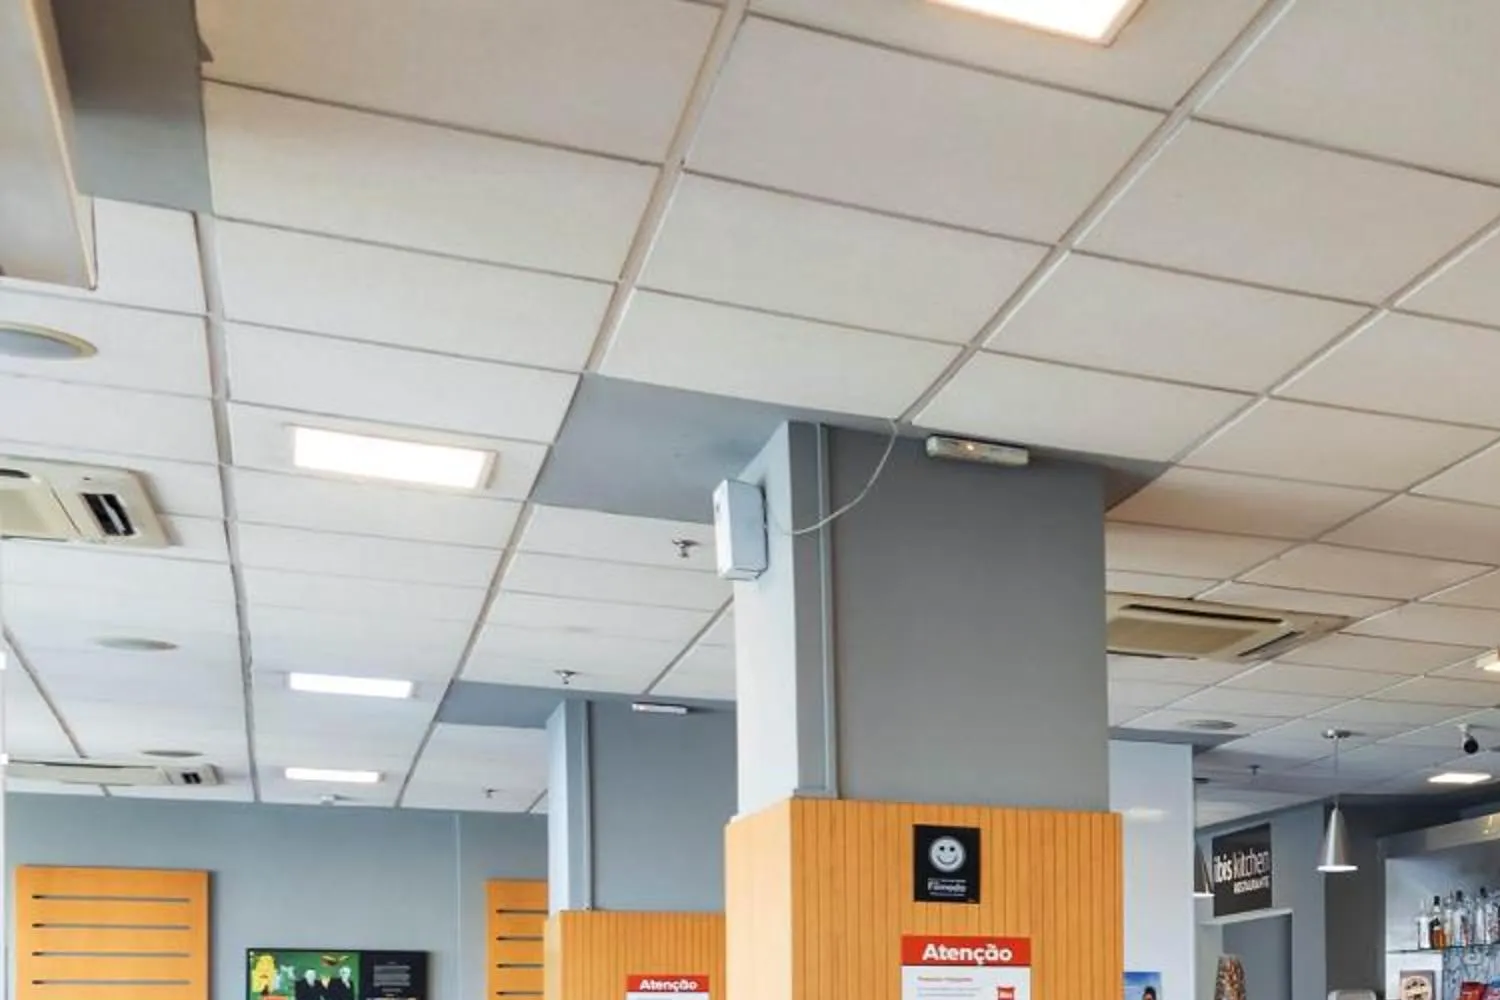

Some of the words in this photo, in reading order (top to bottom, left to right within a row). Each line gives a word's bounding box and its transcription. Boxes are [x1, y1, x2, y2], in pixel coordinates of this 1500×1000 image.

[1213, 853, 1233, 884] ibis
[1233, 847, 1270, 880] kitchen
[922, 943, 1013, 966] Atenção
[639, 978, 699, 993] Atenção
